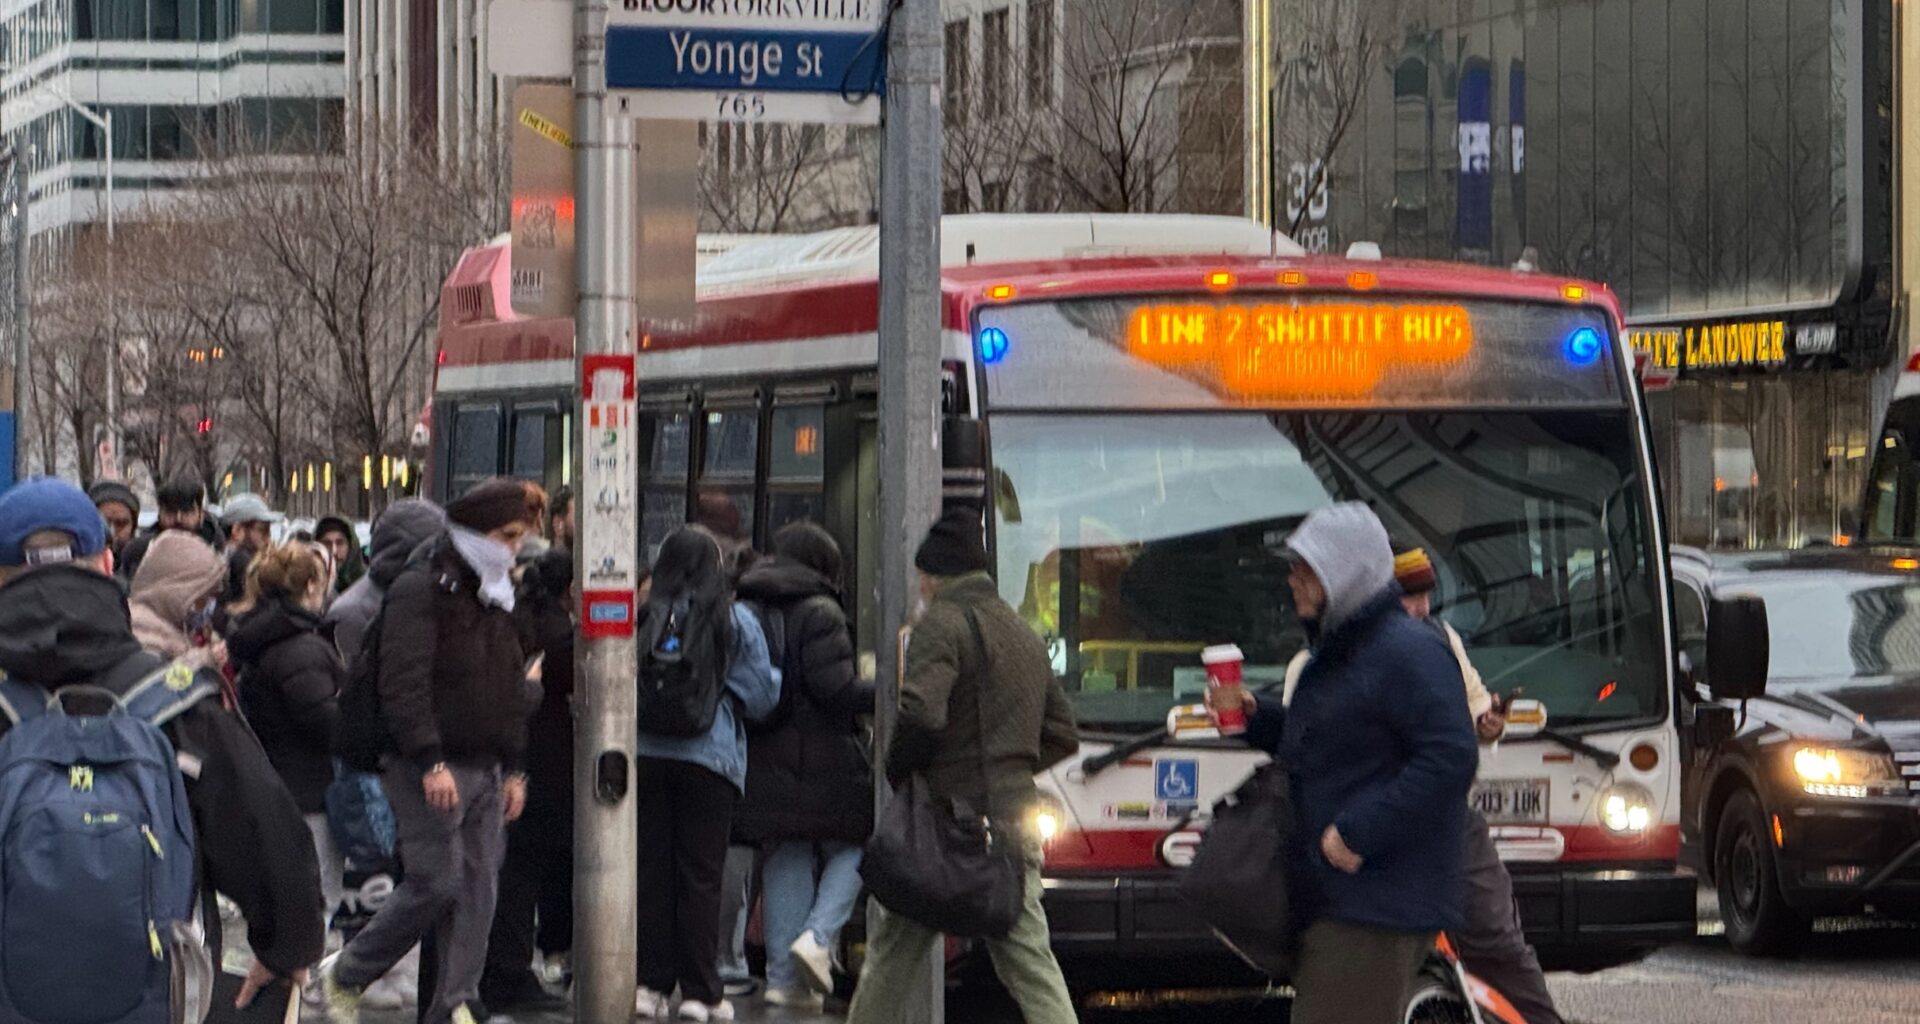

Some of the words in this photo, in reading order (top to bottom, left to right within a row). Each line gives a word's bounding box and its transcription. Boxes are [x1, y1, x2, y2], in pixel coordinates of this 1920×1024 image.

[669, 31, 783, 85] Yonge
[796, 42, 823, 77] St
[716, 93, 766, 117] 765
[1226, 312, 1243, 342] 2
[1403, 311, 1463, 343] BUS
[1685, 321, 1787, 367] LANDWER
